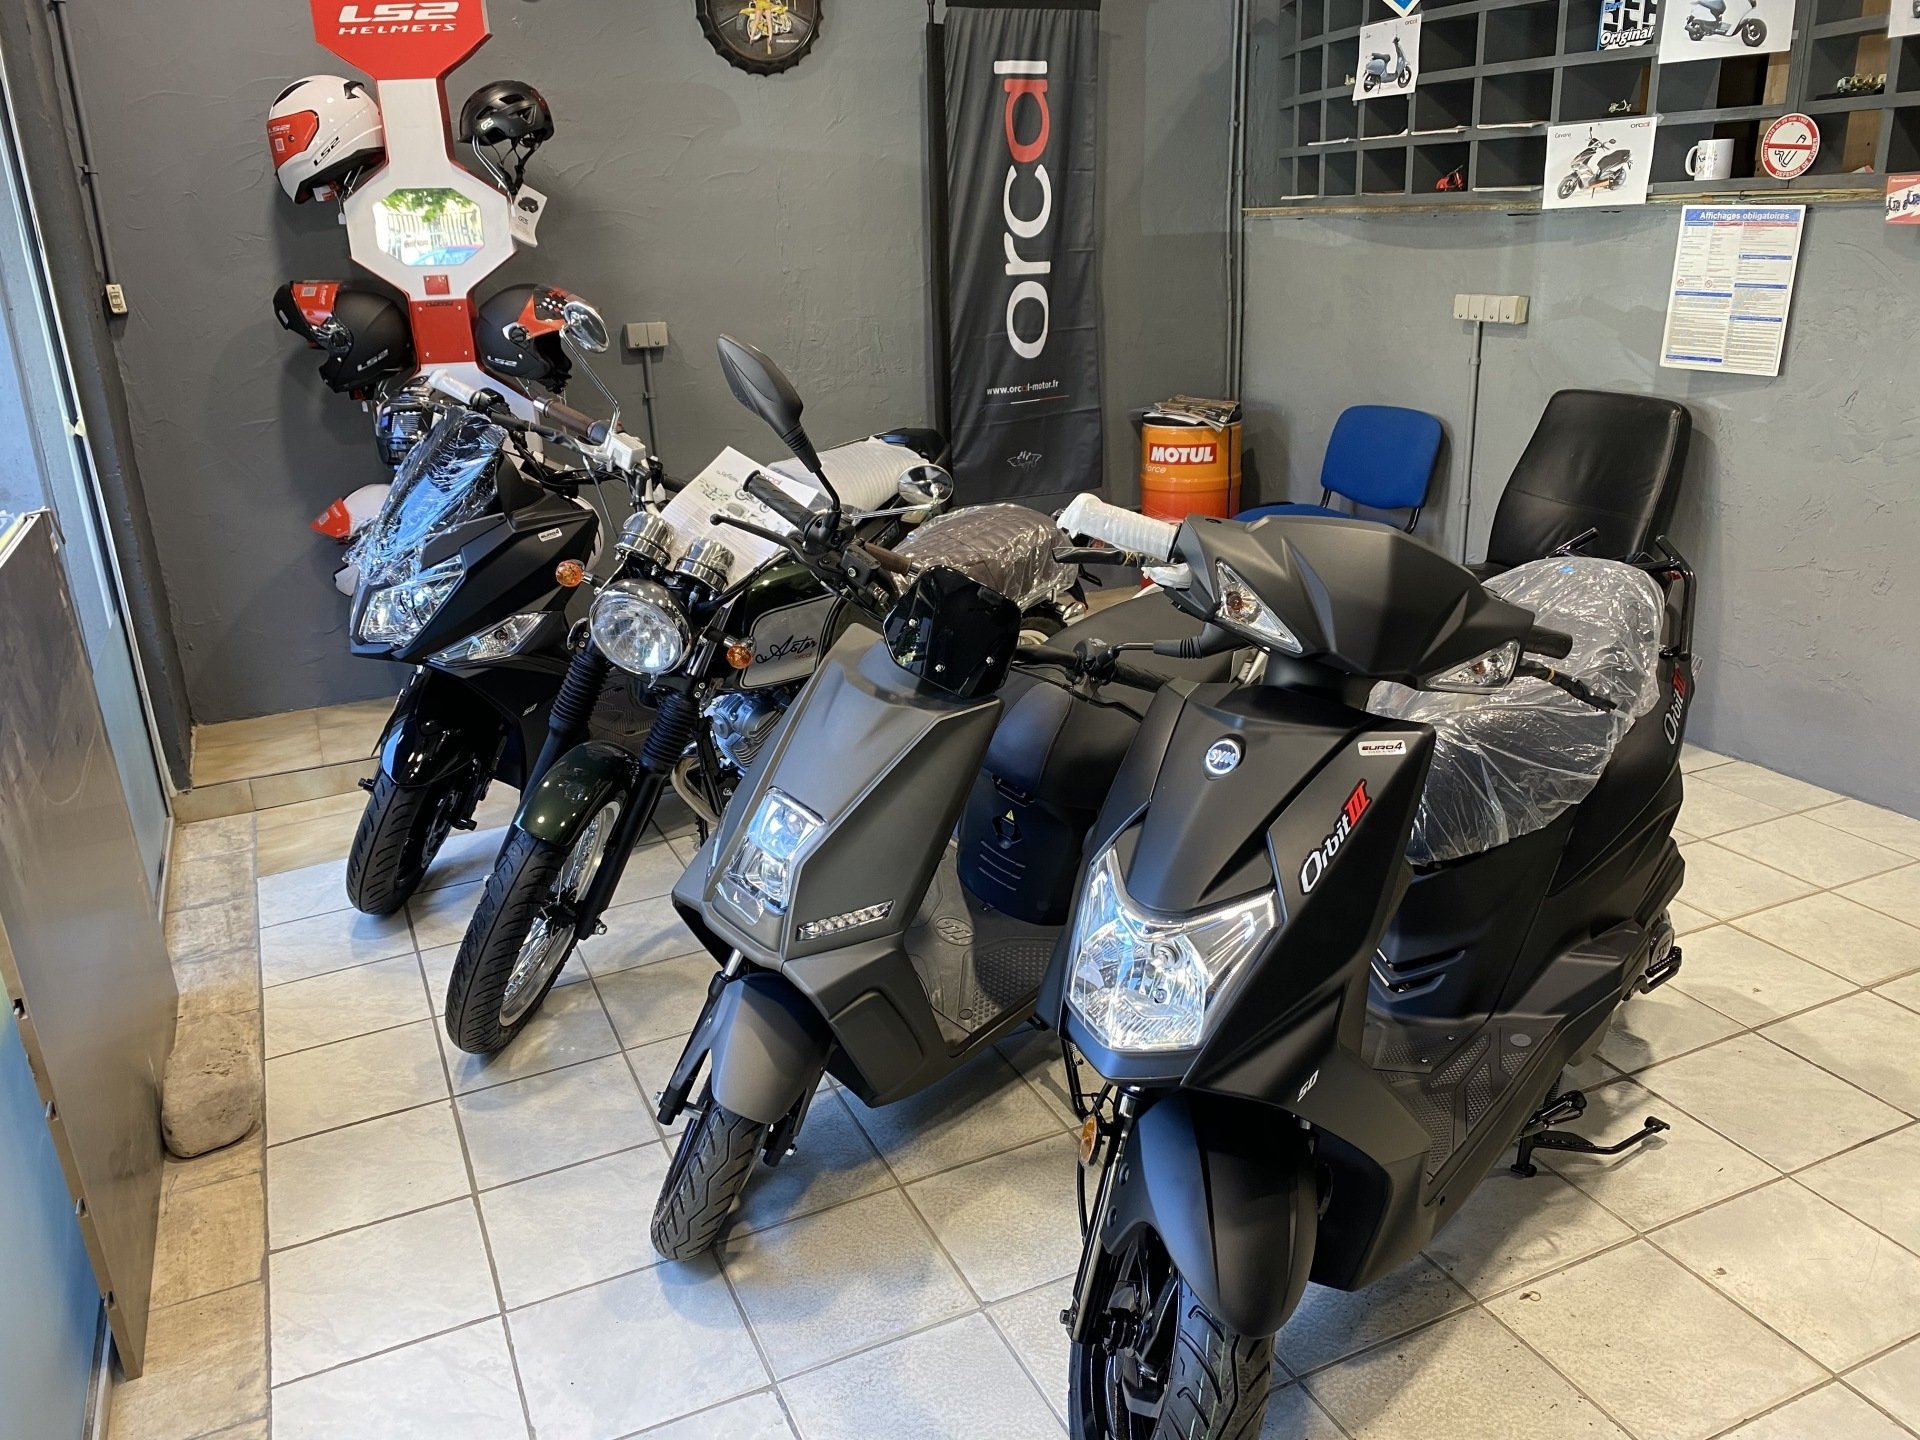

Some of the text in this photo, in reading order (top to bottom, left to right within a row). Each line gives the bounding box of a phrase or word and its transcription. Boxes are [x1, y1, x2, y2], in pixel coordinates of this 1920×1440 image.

[339, 2, 460, 22] LS2
[338, 23, 457, 35] HELMETS
[1600, 26, 1654, 46] Original
[313, 136, 340, 166] LS2
[994, 60, 1053, 359] orcal
[1699, 210, 1790, 221] Affichages obligatoires
[357, 348, 389, 371] LS2
[487, 355, 517, 367] LS2
[1150, 446, 1214, 463] MOTUL
[1207, 748, 1237, 766] SYM
[1297, 1069, 1319, 1102] 50
